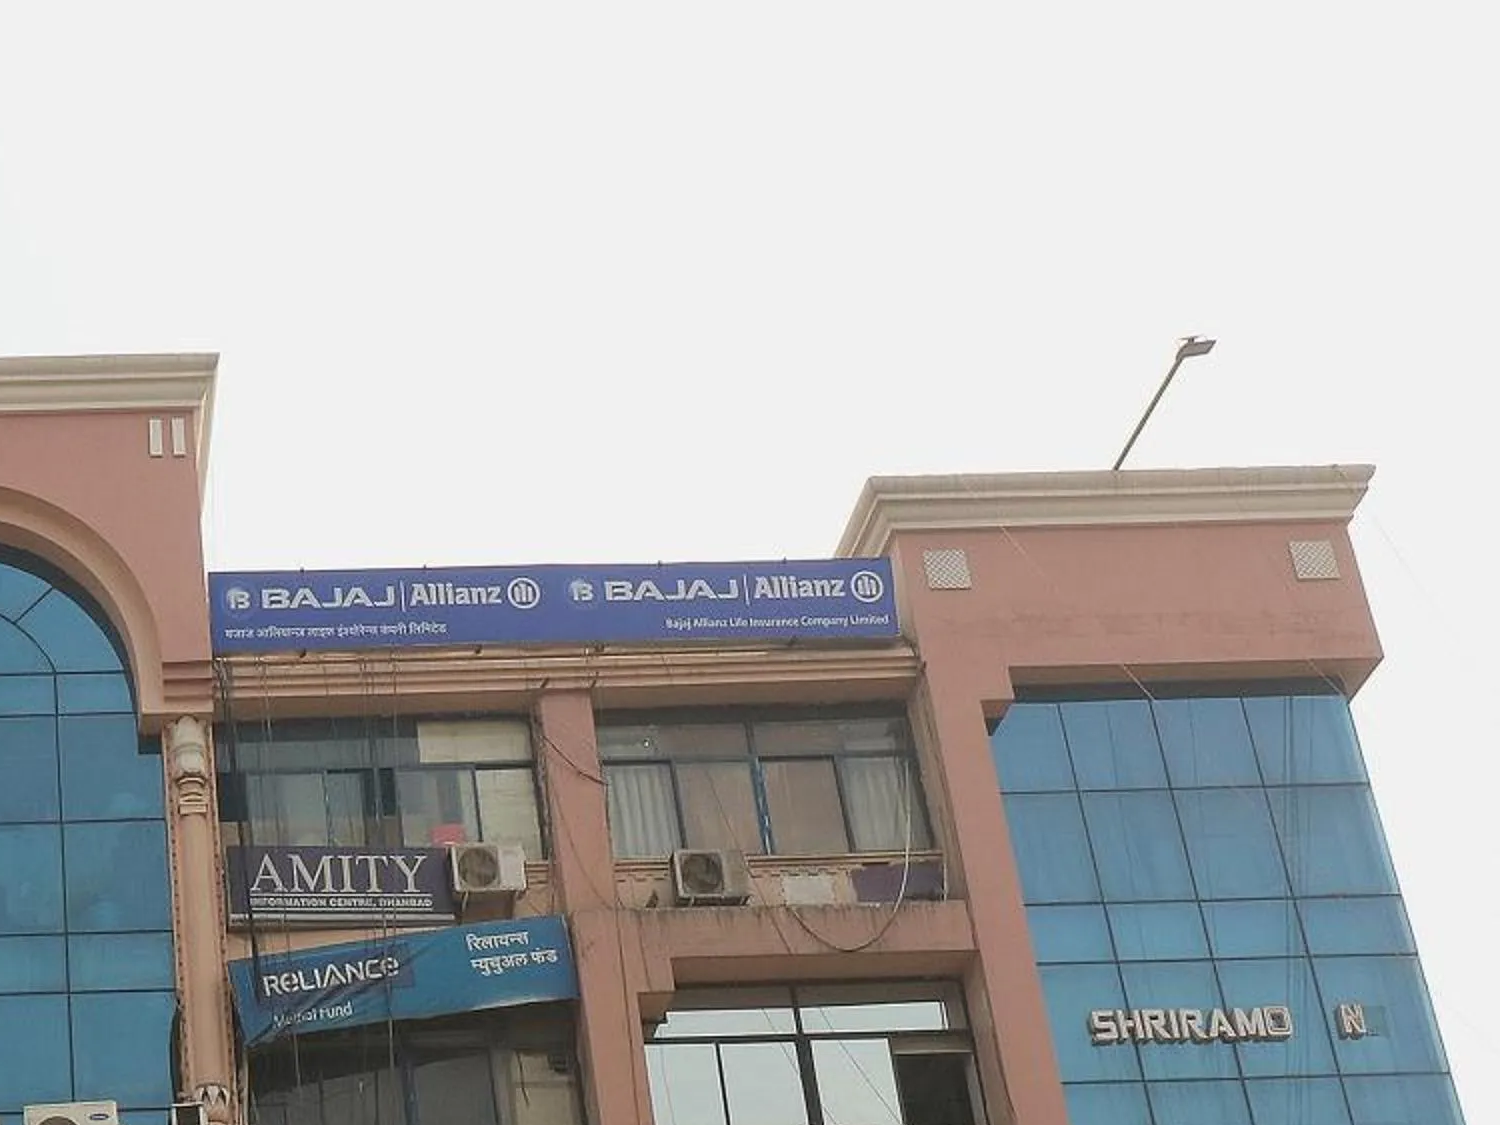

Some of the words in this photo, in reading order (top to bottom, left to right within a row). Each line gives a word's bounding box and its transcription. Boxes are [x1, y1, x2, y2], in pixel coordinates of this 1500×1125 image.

[261, 587, 396, 609] BAJAJ
[410, 581, 501, 608] Allianz
[604, 579, 739, 602] BAJAJ
[754, 574, 845, 600] Allianz
[693, 617, 728, 628] Allianz
[730, 617, 747, 627] Life
[750, 616, 799, 627] Insurance
[801, 615, 849, 629] Company
[851, 613, 889, 625] Limited
[249, 852, 428, 894] AMITY
